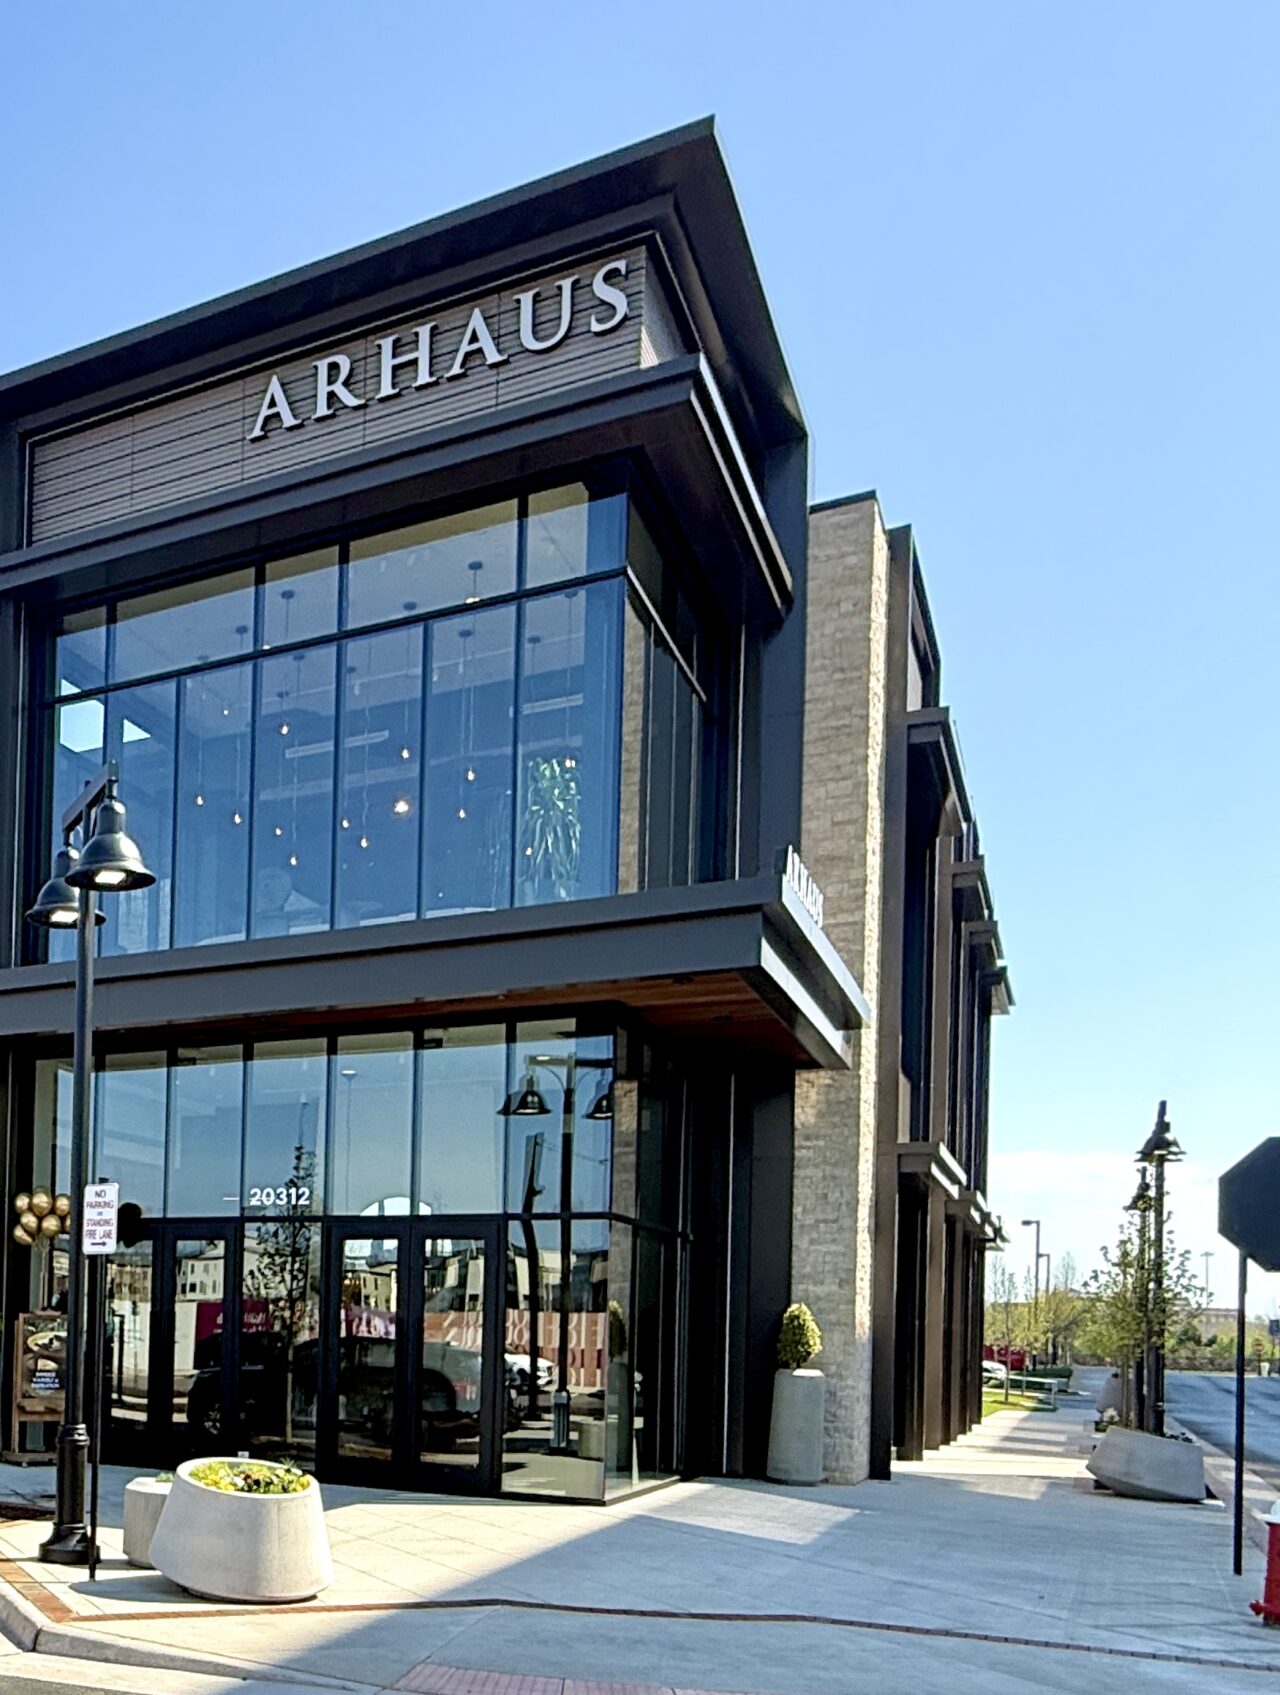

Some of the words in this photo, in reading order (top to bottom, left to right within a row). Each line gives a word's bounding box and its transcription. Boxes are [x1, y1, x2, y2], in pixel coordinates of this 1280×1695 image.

[246, 259, 630, 441] ARHAUS
[95, 1190, 107, 1198] NO
[249, 1186, 311, 1206] 20312
[86, 1200, 114, 1209] PARKING
[85, 1218, 114, 1227] STANDING
[85, 1229, 98, 1240] FIRE
[99, 1229, 113, 1240] LANE
